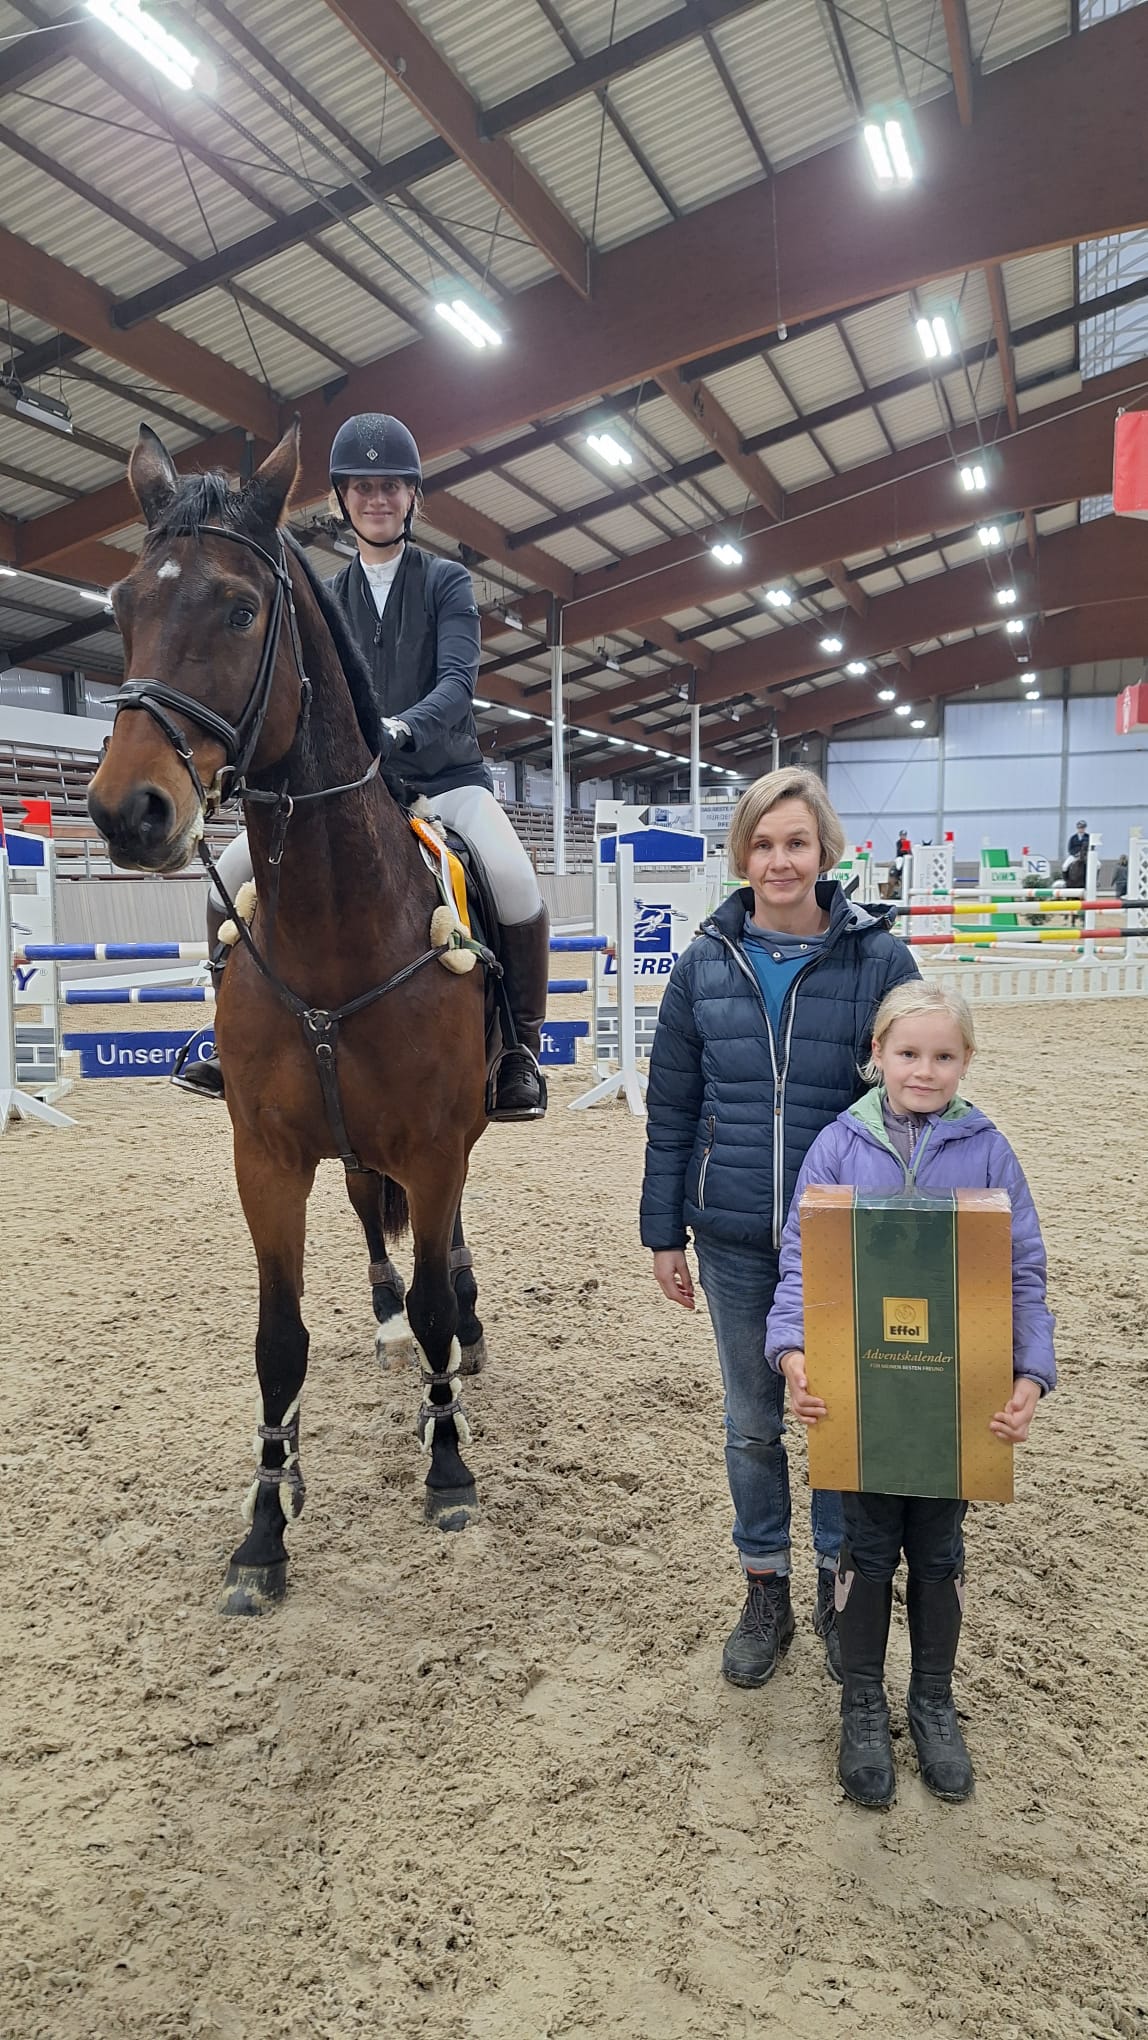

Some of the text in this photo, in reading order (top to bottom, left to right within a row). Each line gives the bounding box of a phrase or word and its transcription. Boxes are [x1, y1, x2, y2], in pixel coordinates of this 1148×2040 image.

[1027, 860, 1047, 873] NE
[603, 953, 679, 975] DERB
[96, 1043, 189, 1065] Unsere
[889, 1325, 921, 1337] Effol
[862, 1348, 954, 1363] Adventskalender
